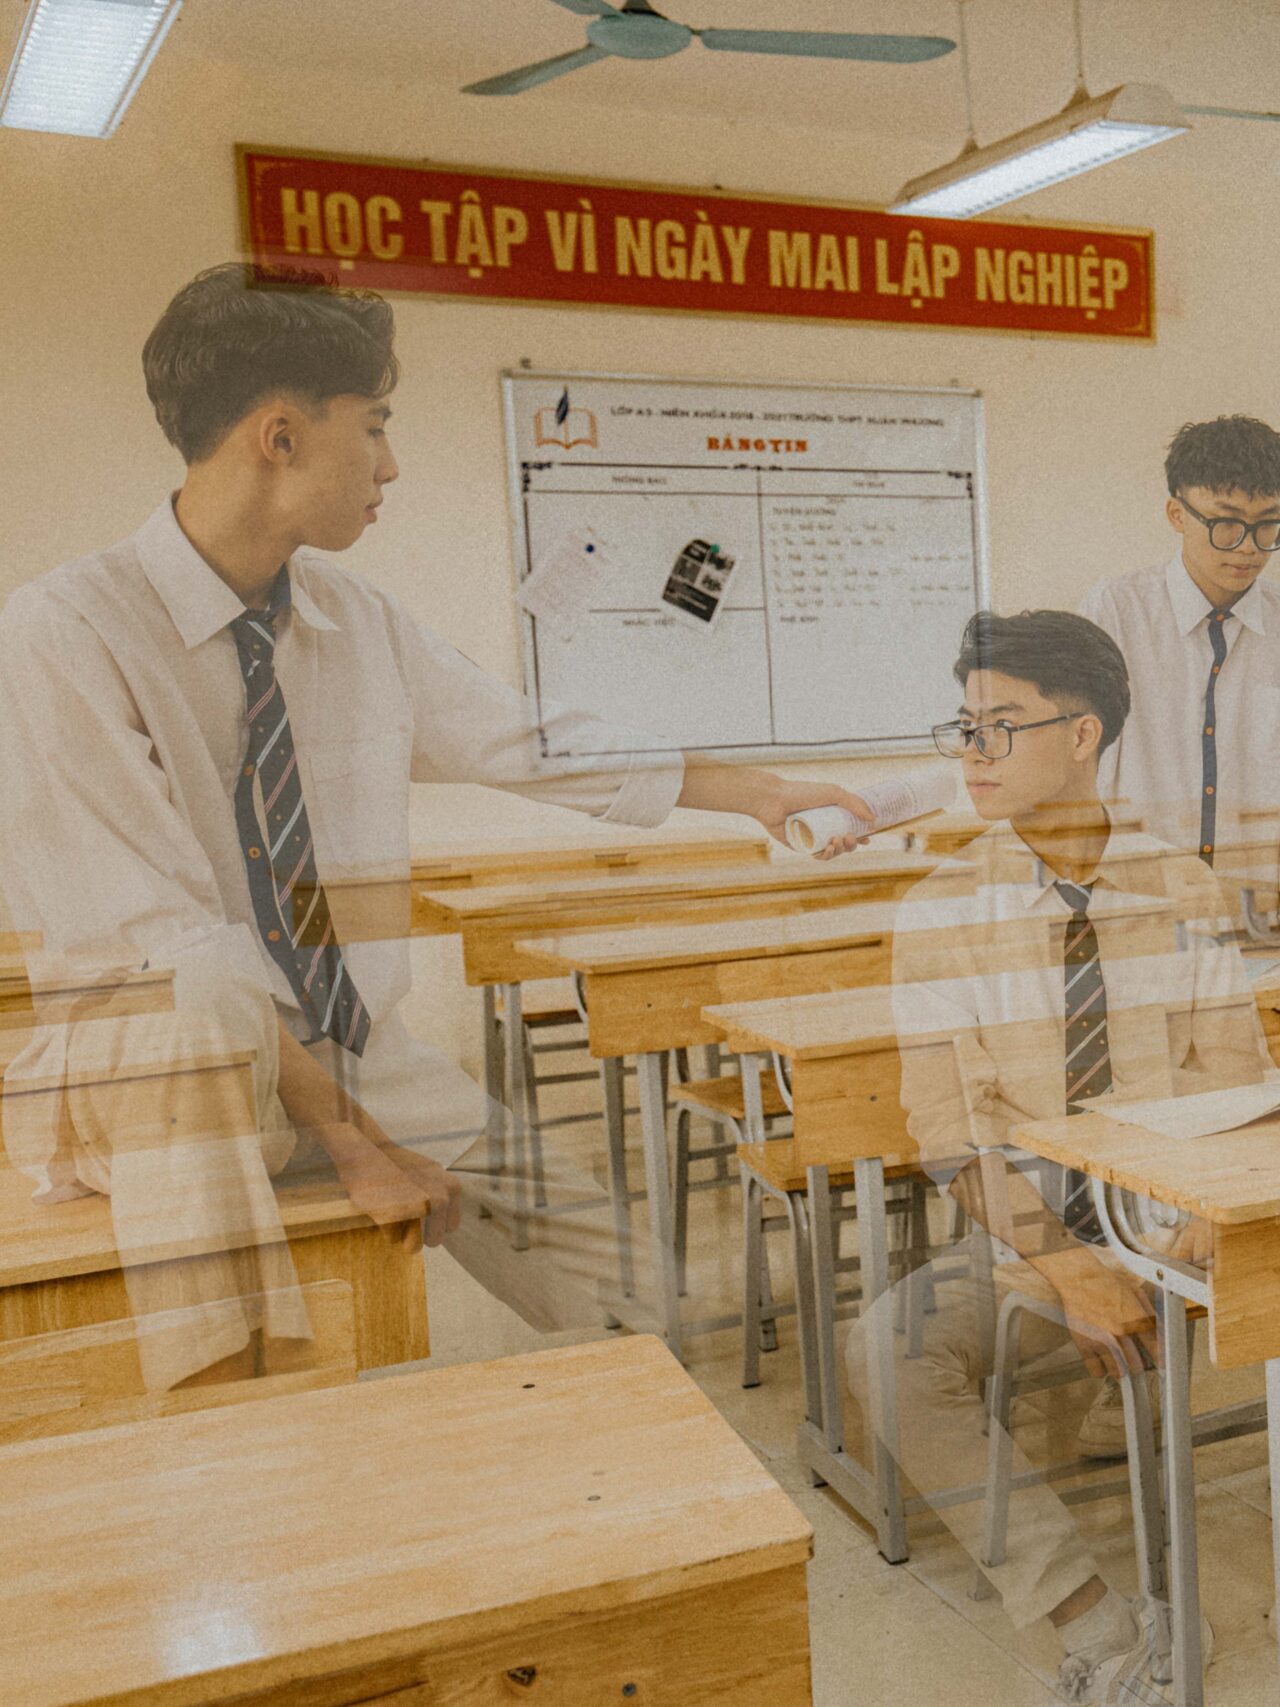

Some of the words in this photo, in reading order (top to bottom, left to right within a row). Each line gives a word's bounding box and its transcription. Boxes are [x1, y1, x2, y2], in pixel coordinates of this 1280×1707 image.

[281, 188, 403, 271] HỌC
[421, 190, 529, 278] TẬP
[545, 199, 598, 273] VÌ
[615, 210, 752, 284] NGÀY
[768, 230, 860, 292] MAI
[876, 230, 960, 308] LẬP
[975, 244, 1128, 319] NGHIỆP
